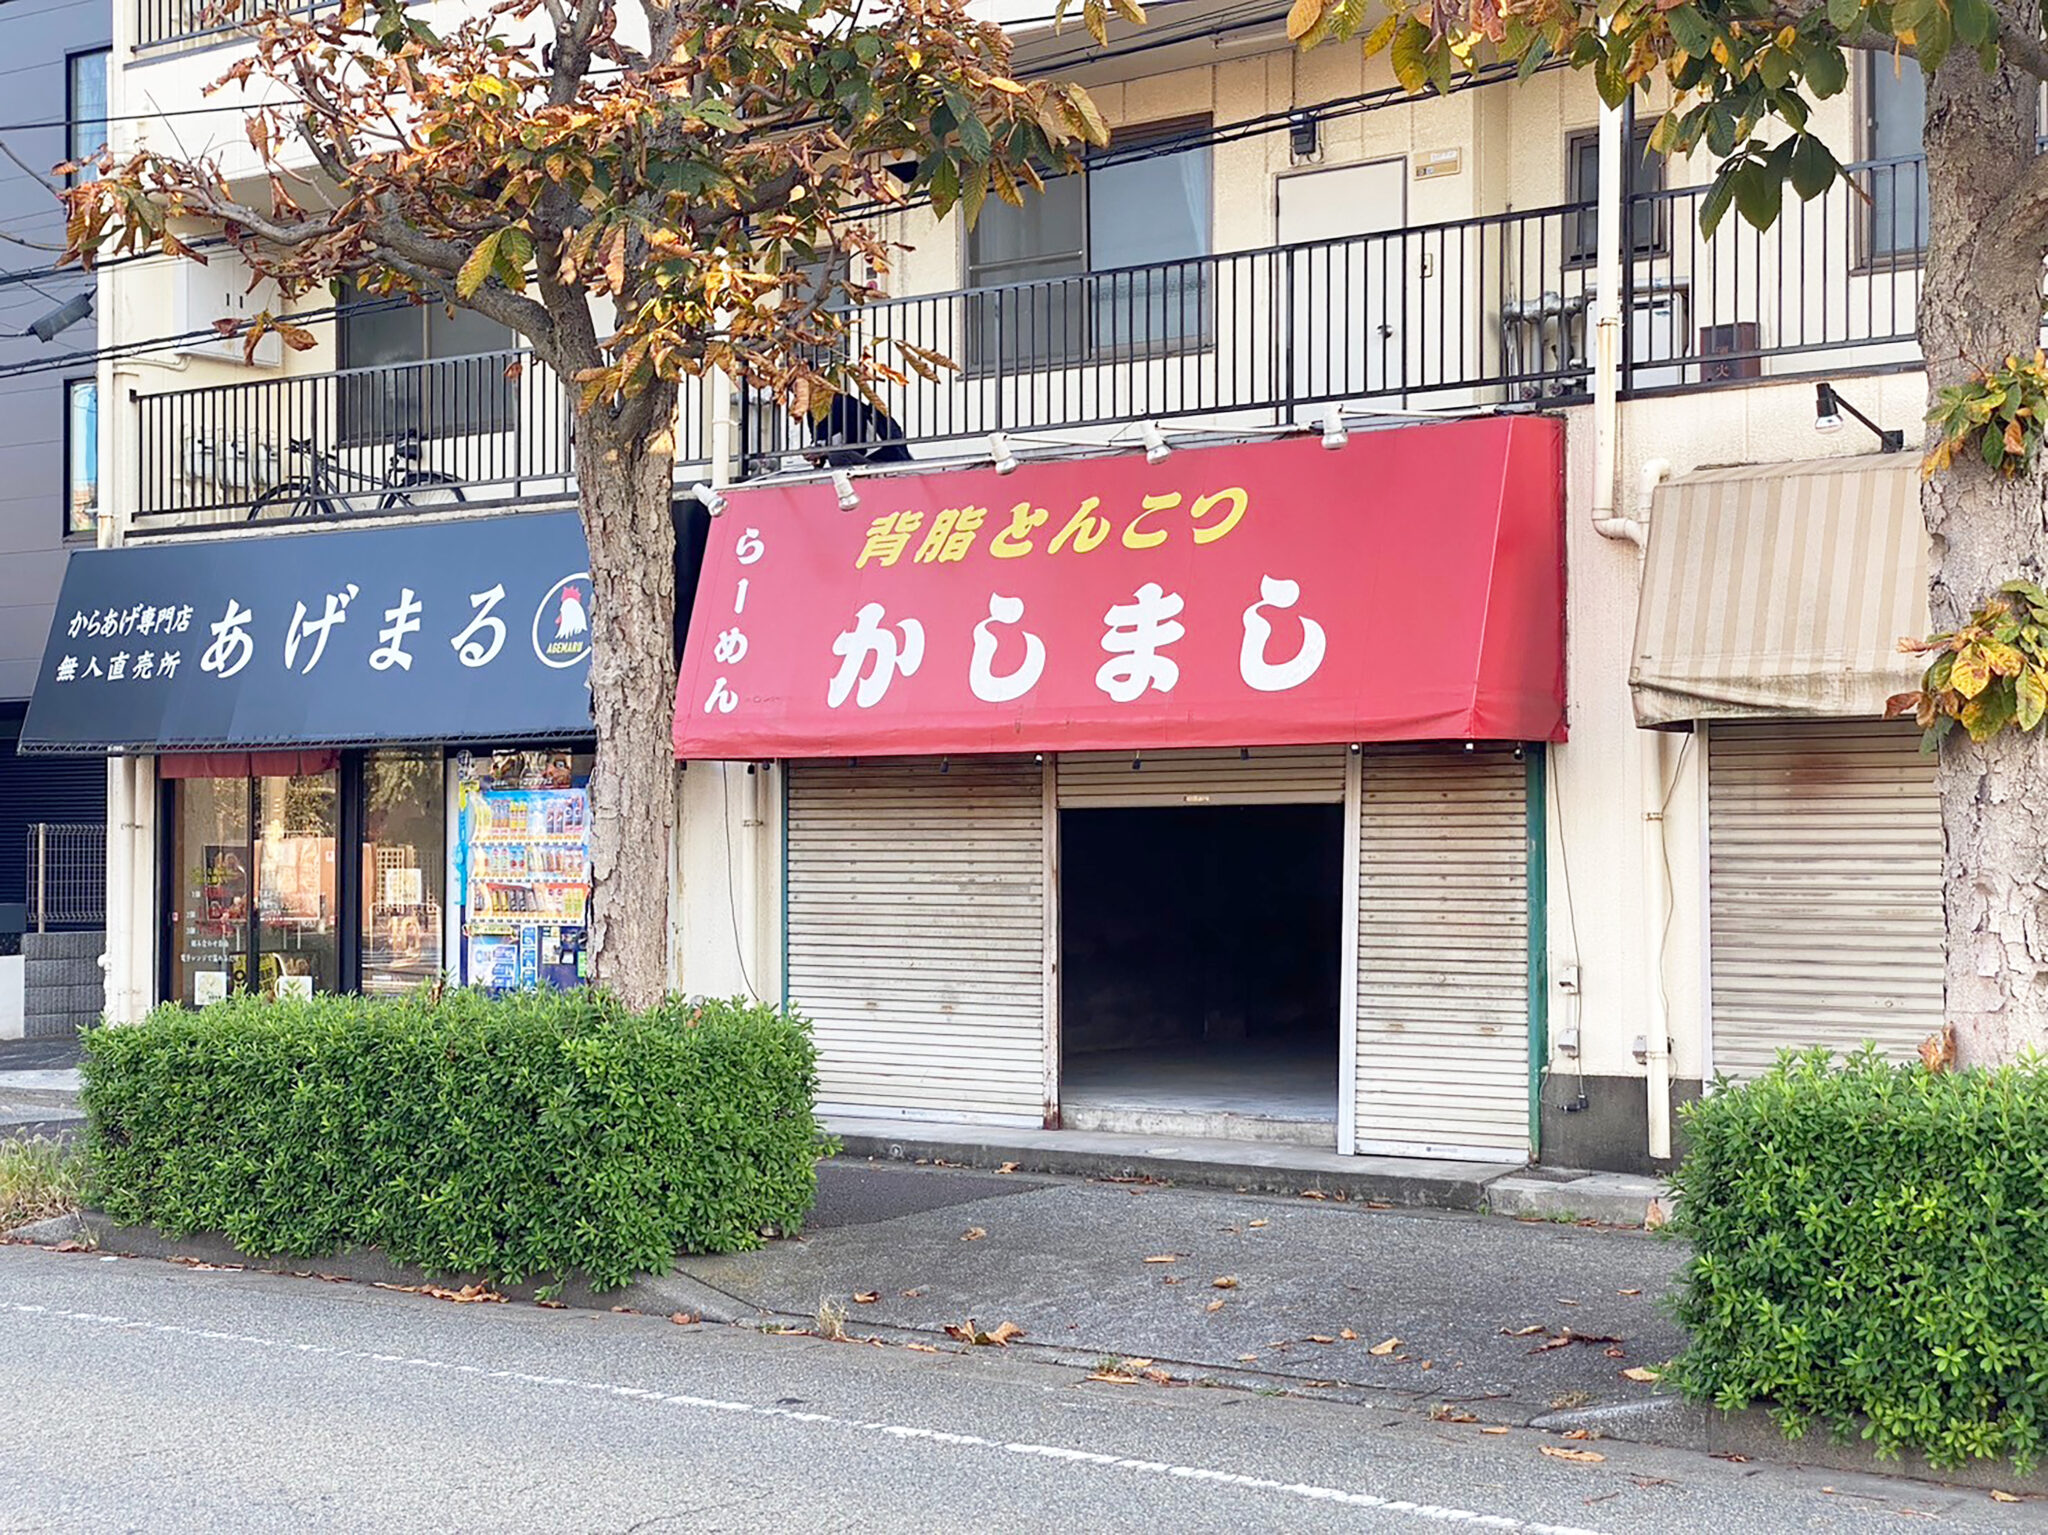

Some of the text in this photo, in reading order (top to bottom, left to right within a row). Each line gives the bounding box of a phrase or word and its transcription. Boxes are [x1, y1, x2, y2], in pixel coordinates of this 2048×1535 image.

[855, 487, 1249, 569] 背脂とんこつ
[67, 603, 194, 638] からあげ専門店
[200, 583, 506, 678] あげまる
[704, 527, 765, 714] らーめん
[827, 574, 1327, 709] かしまし
[56, 650, 181, 682] 無人直売所
